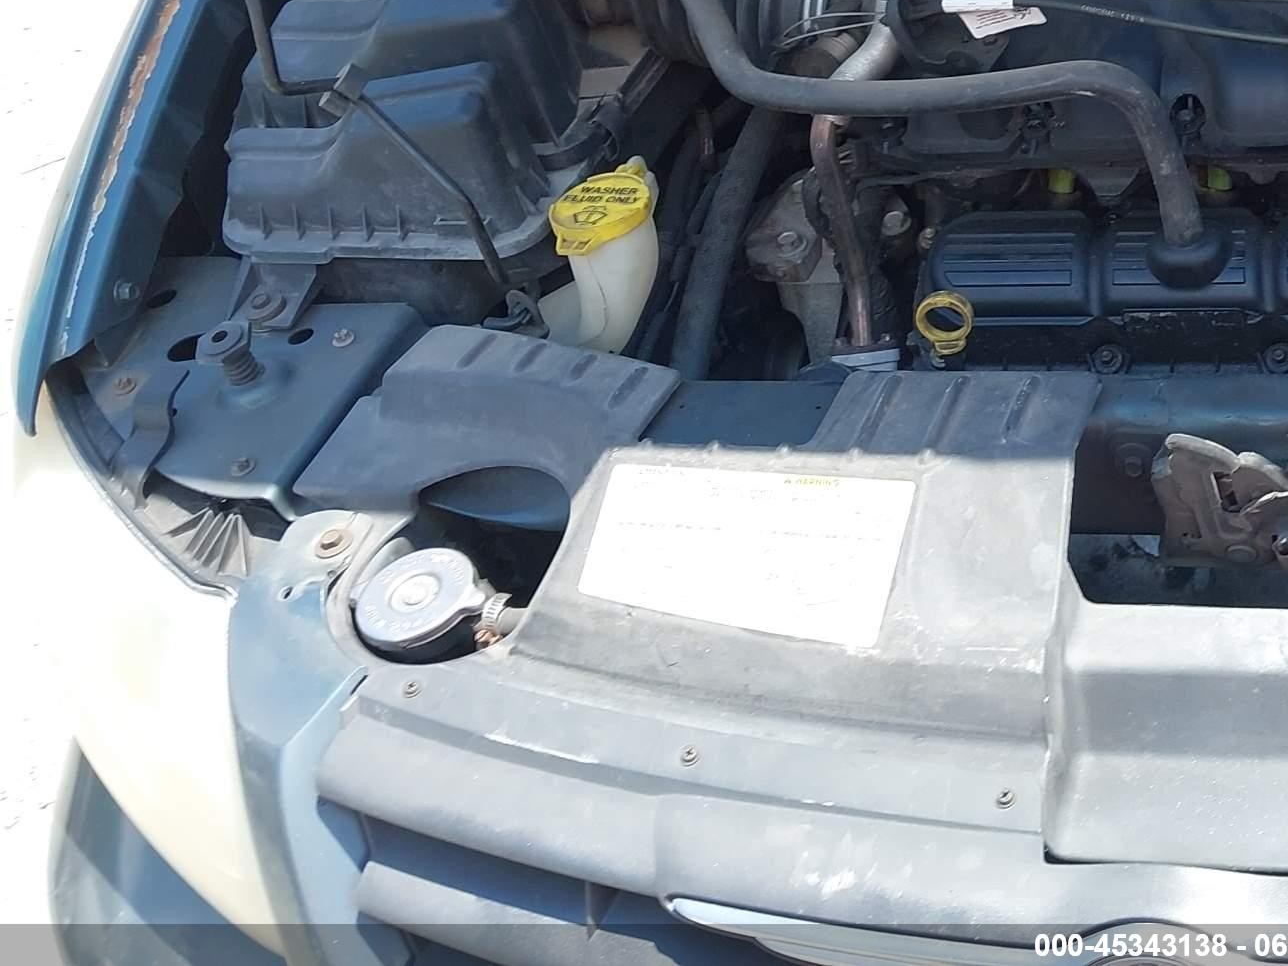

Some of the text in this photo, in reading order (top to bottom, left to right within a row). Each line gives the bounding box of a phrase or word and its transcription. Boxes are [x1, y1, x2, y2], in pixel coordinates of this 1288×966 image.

[581, 186, 638, 194] WASHER
[563, 195, 641, 203] FLUID ONLY
